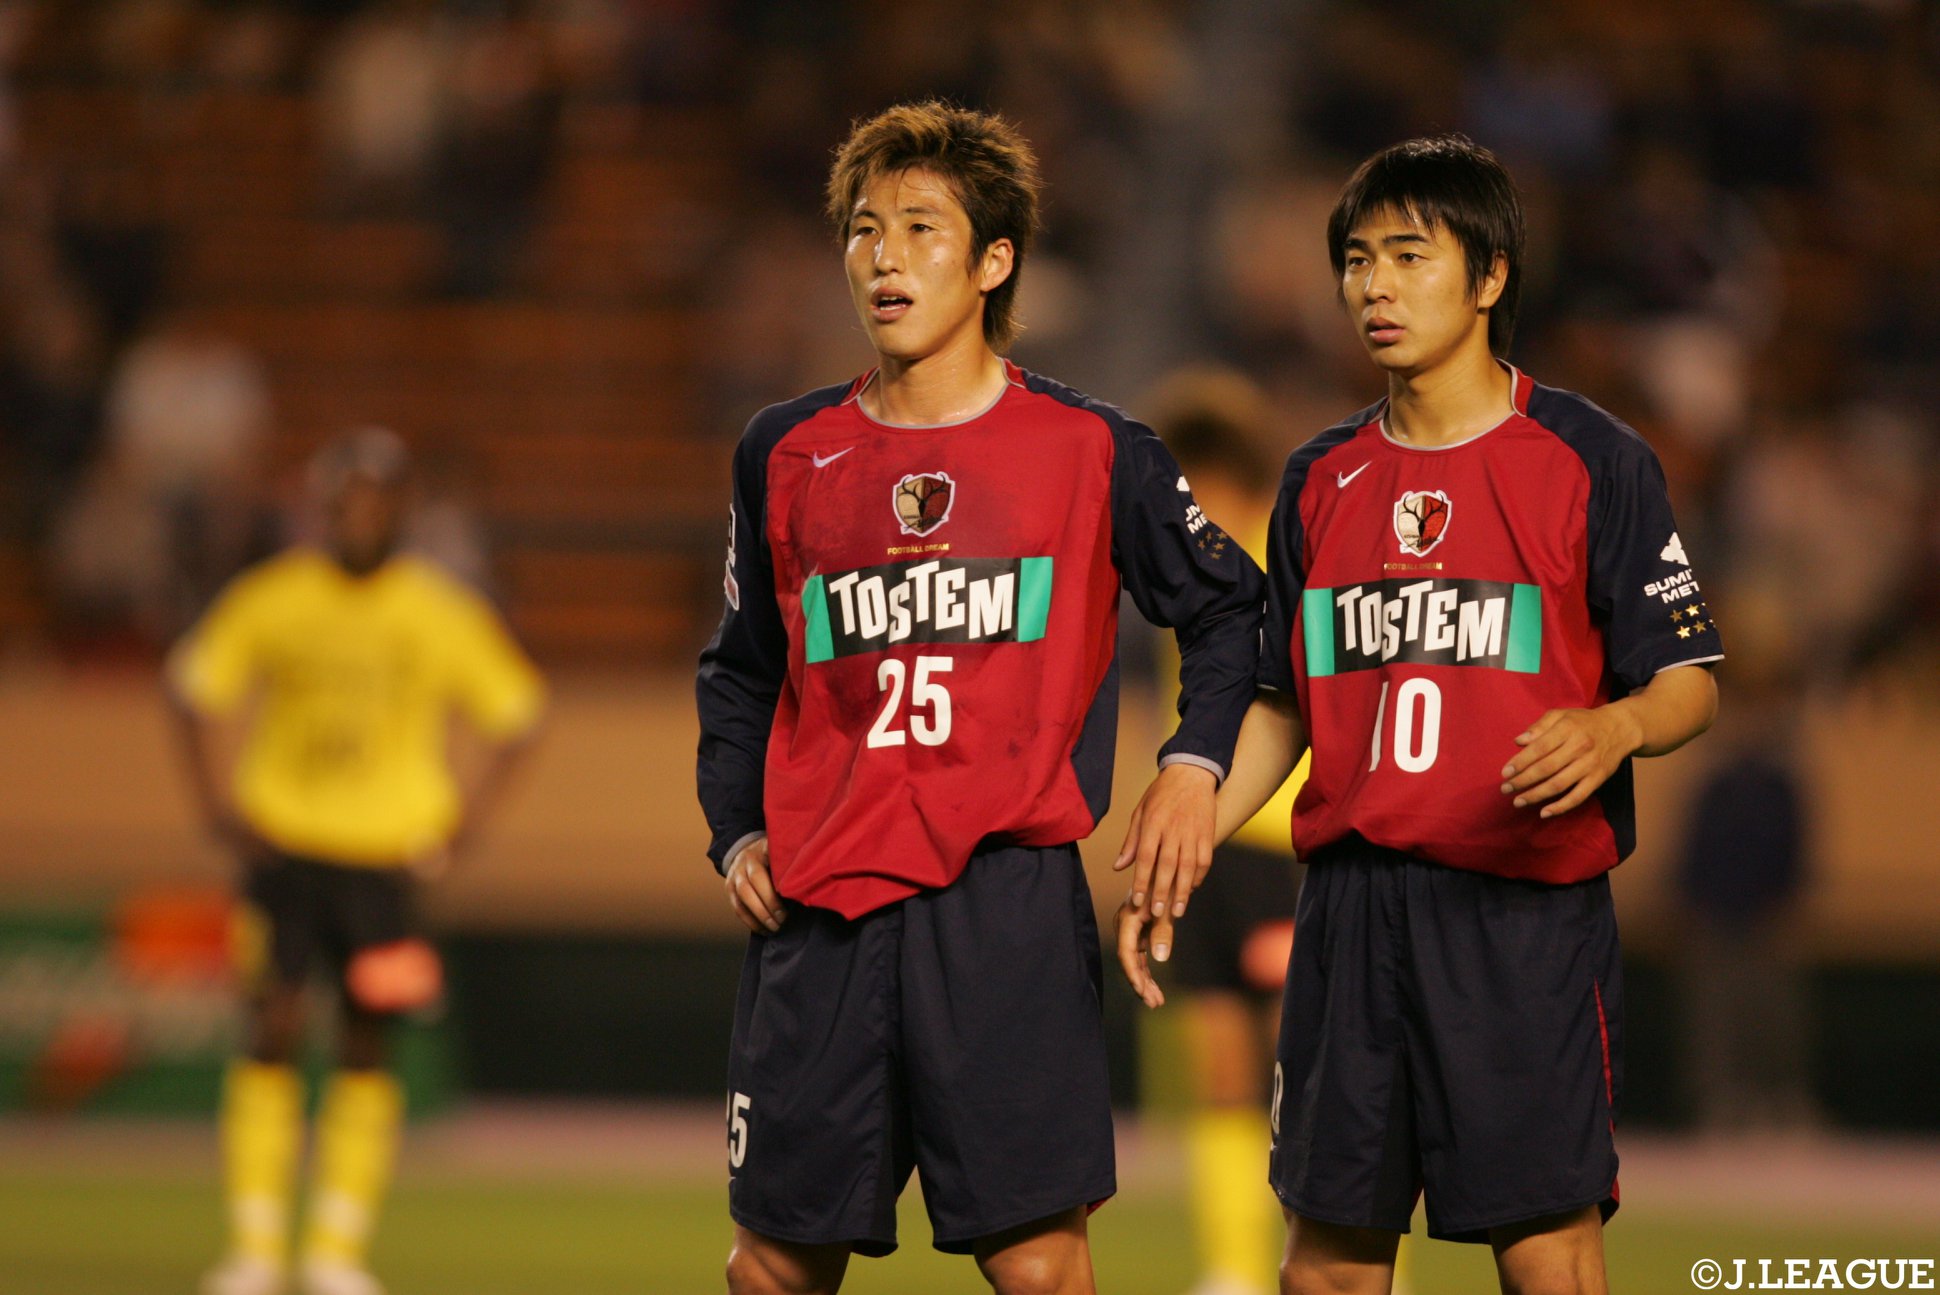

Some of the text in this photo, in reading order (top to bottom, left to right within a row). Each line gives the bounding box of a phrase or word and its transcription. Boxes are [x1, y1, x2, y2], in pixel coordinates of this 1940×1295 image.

[887, 546, 923, 555] FOOTBALL
[1644, 568, 1693, 597] SUMI
[829, 560, 1015, 644] TOSTEM
[1336, 580, 1506, 662] TOSTEM
[867, 655, 954, 749] 25
[726, 1088, 751, 1168] 5
